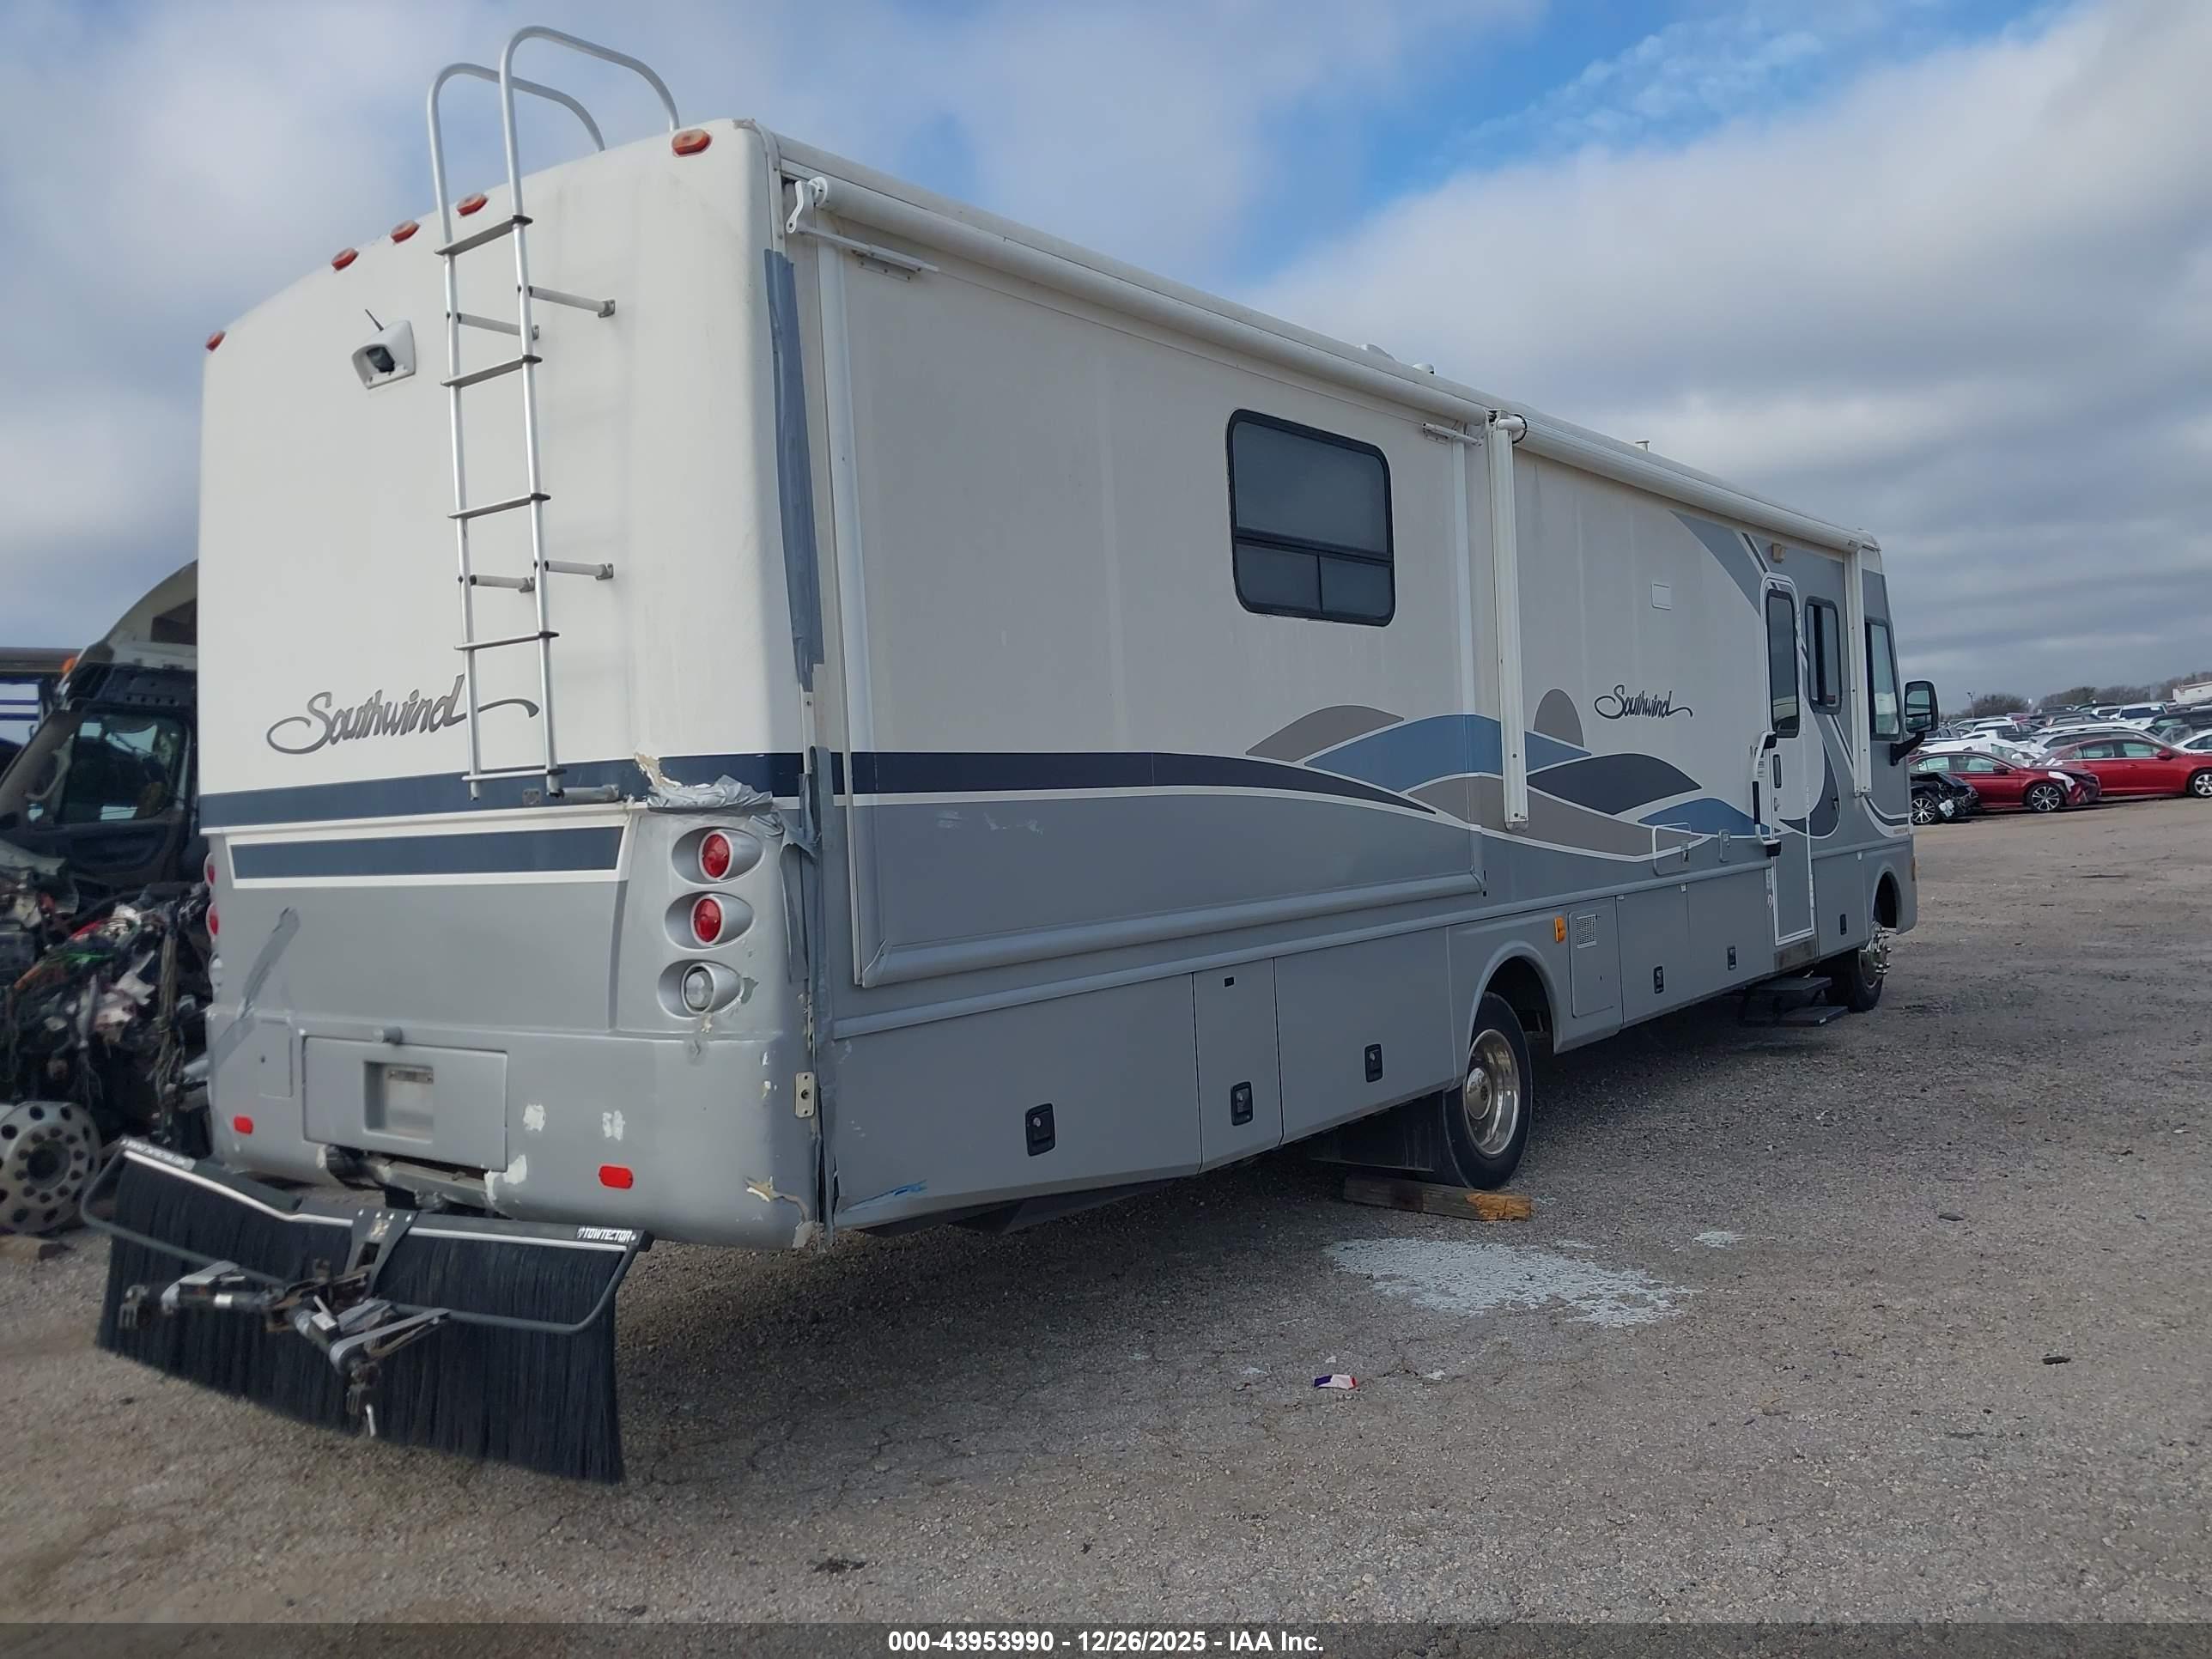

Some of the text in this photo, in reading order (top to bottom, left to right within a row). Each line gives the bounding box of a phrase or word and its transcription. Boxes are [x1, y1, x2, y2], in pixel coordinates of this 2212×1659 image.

[266, 673, 540, 755] Southwind
[1594, 684, 1693, 720] Southwind
[582, 1227, 634, 1243] TOWTECTOR
